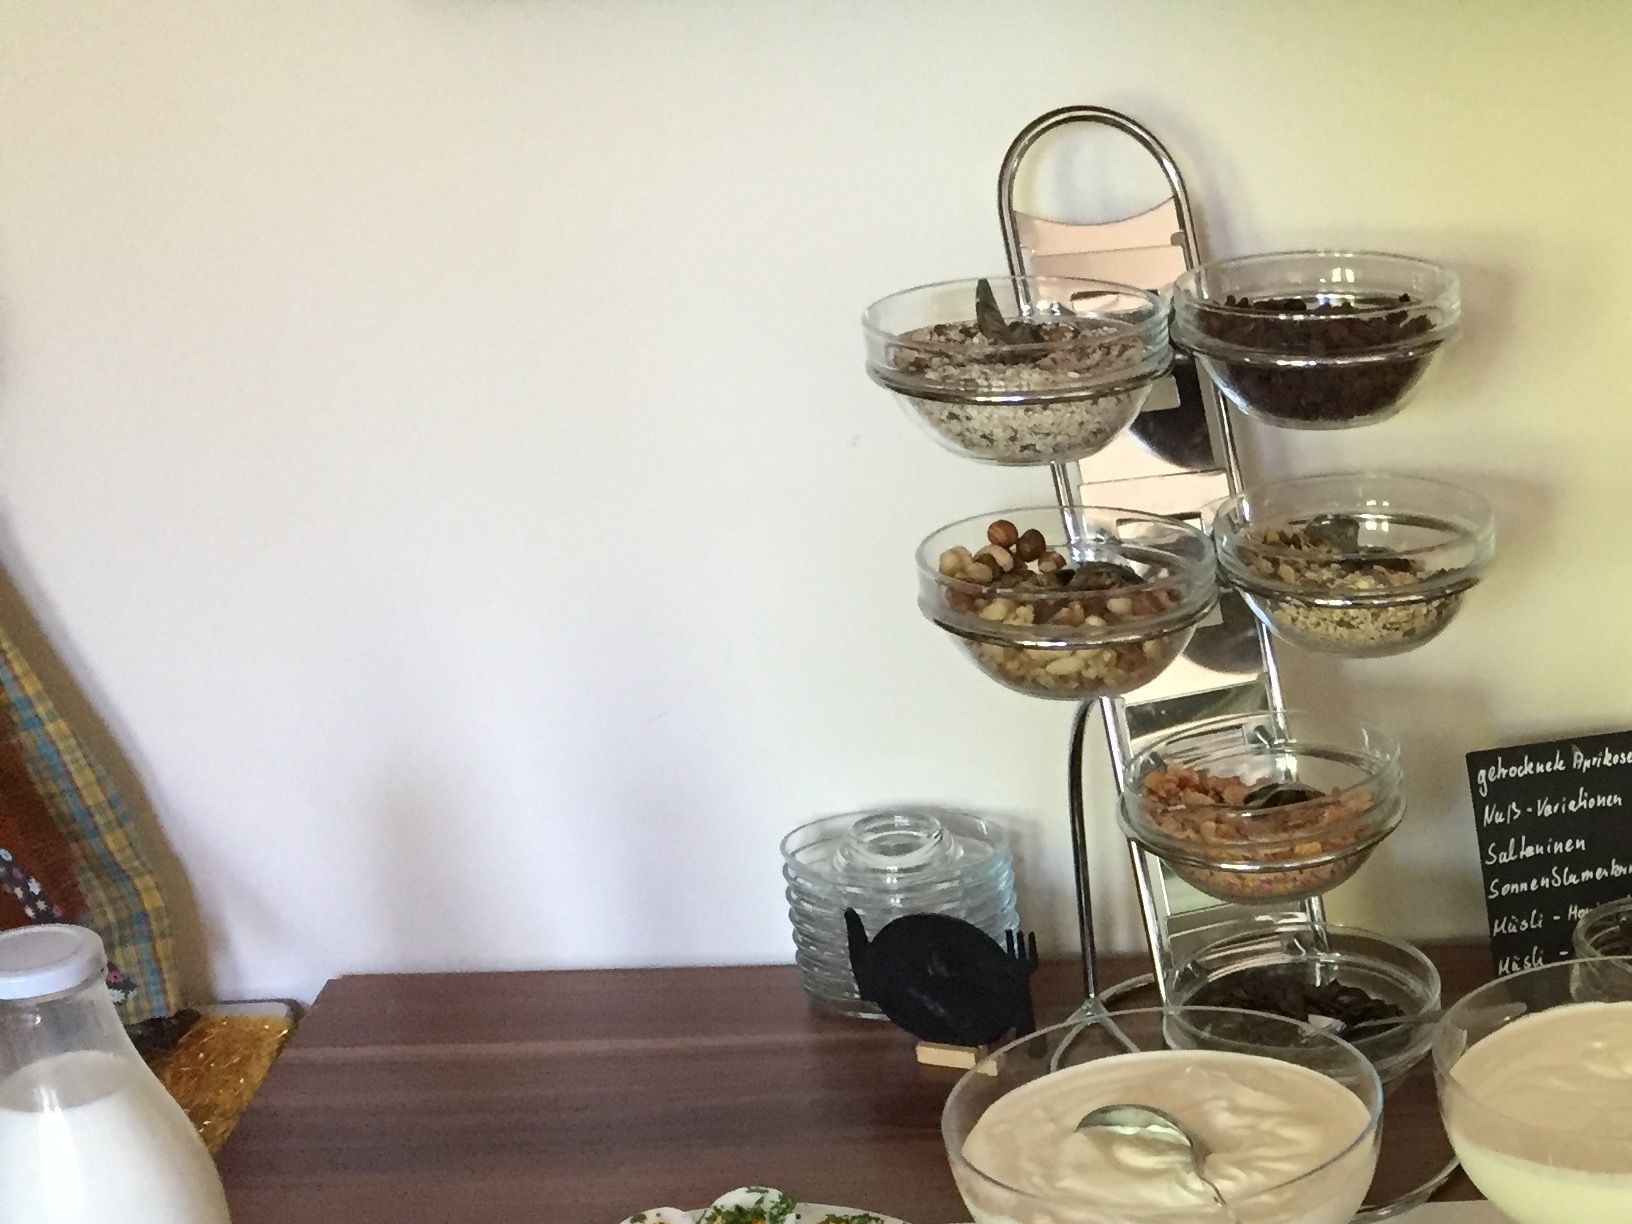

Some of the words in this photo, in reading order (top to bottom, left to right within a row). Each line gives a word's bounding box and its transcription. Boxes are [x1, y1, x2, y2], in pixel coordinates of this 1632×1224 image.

[1477, 751, 1565, 797] getrocknete
[1492, 909, 1544, 937] Müsli
[1498, 945, 1544, 976] Müsli
